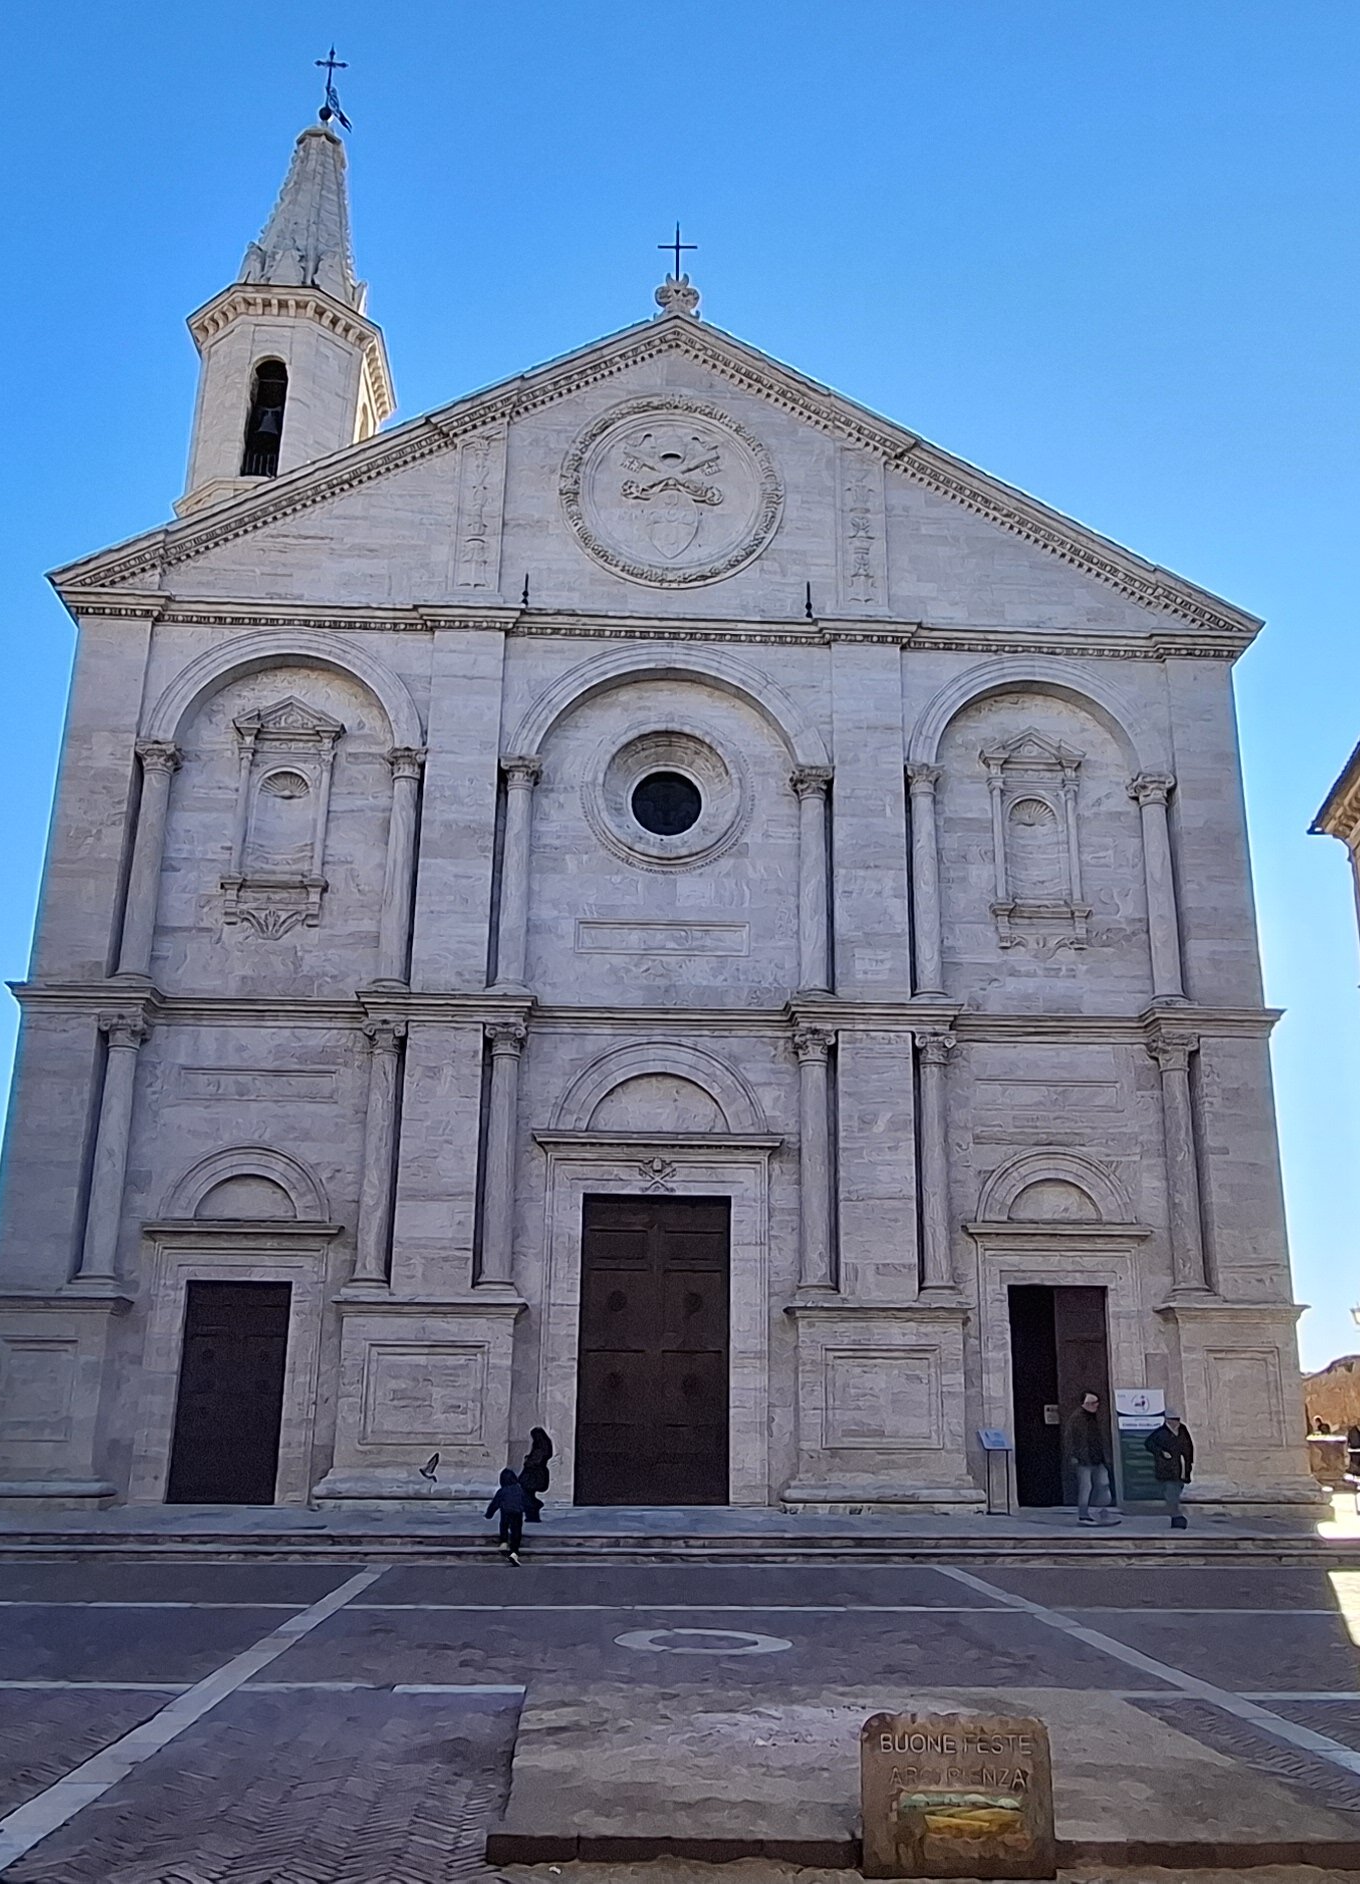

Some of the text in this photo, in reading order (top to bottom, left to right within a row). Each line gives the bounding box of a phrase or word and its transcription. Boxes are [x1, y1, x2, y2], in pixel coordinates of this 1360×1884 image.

[880, 1732, 1033, 1755] BUONE FESTE
[946, 1766, 1027, 1789] PIENZA
